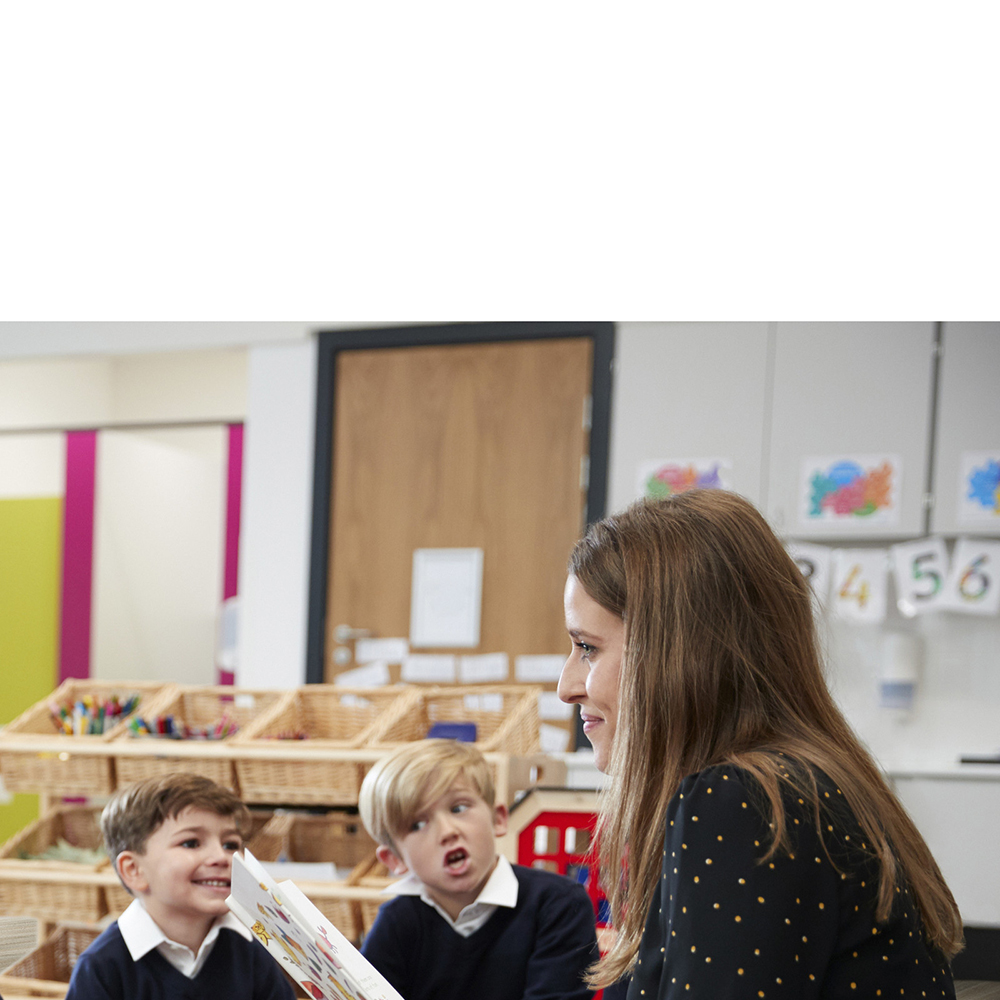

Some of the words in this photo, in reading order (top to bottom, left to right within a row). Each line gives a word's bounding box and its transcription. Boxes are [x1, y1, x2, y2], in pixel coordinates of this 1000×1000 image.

[838, 564, 869, 608] 4
[911, 552, 942, 600] 5
[958, 553, 990, 601] 6
